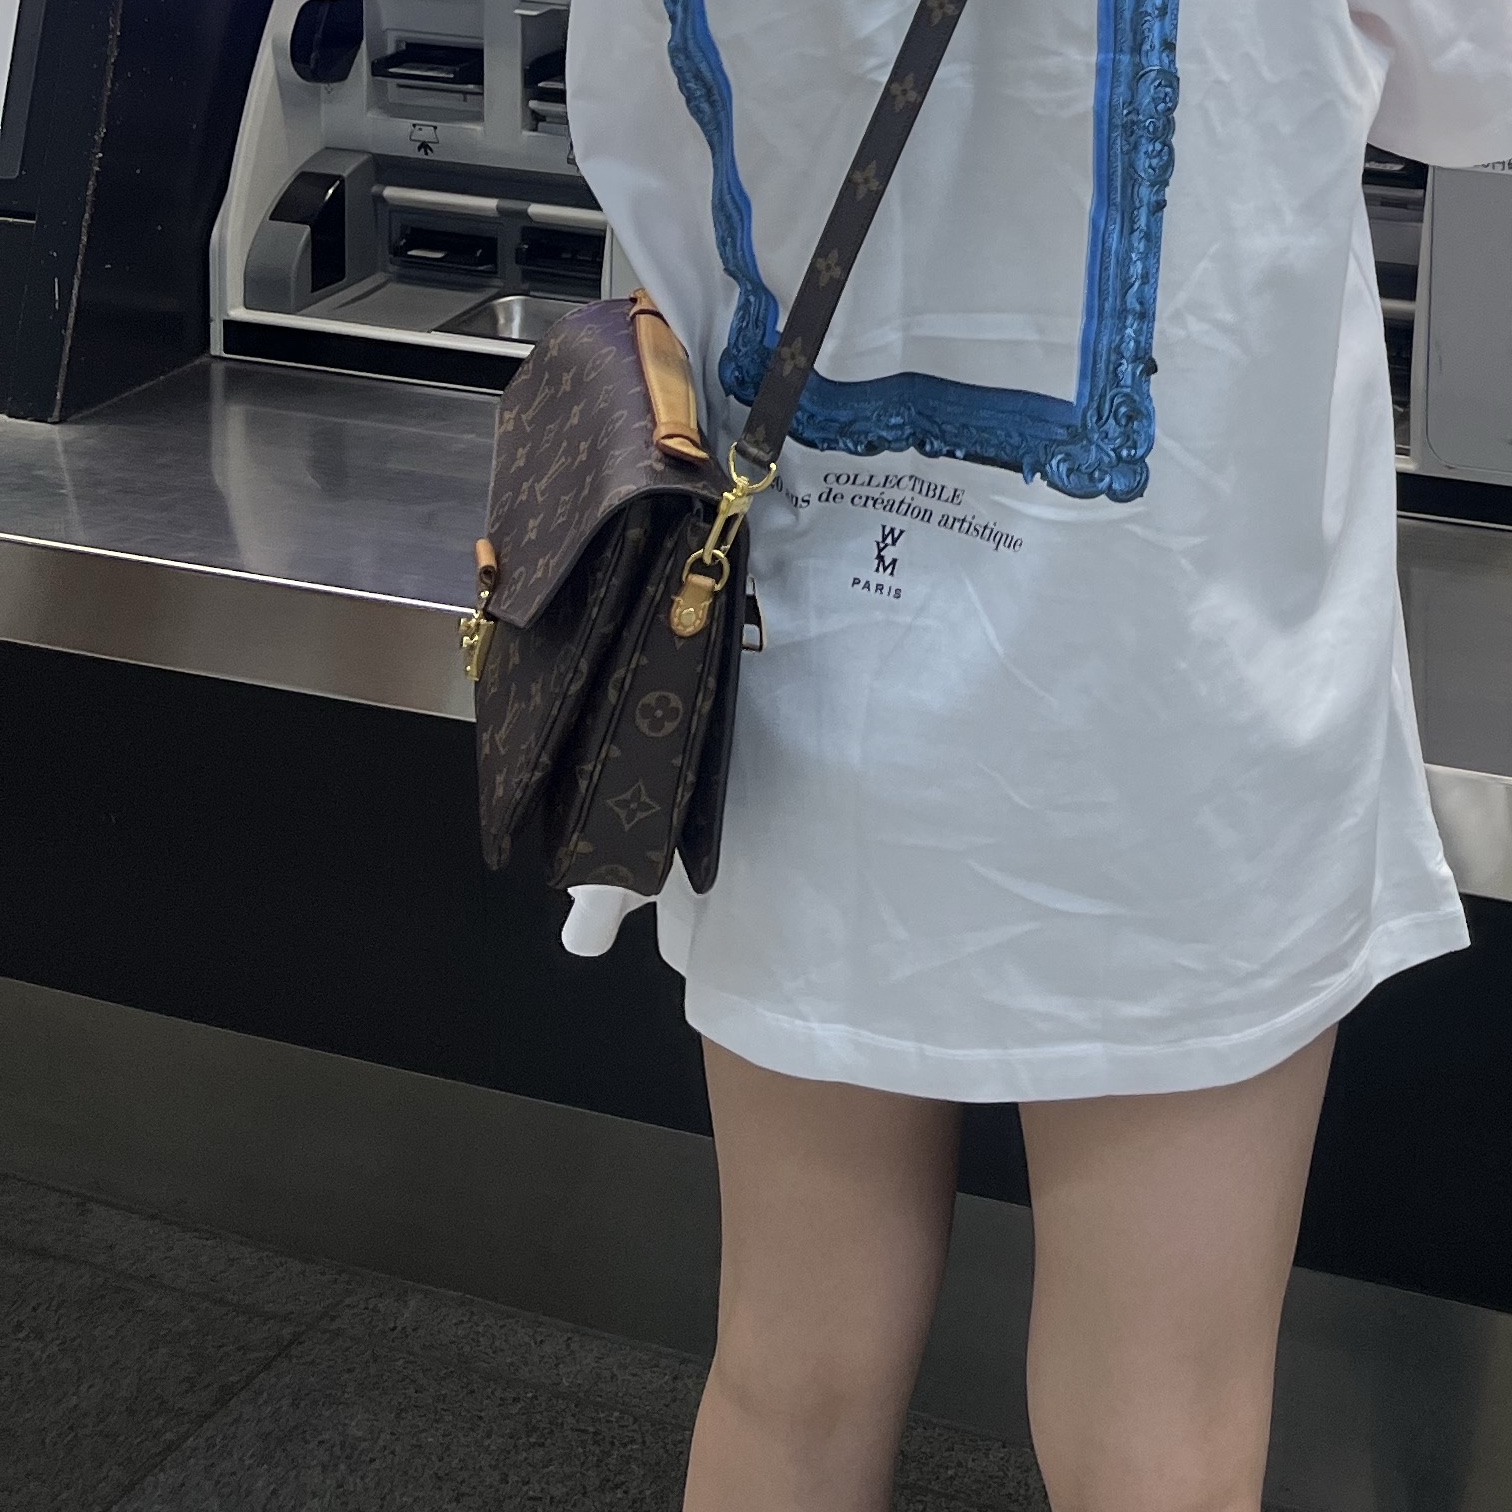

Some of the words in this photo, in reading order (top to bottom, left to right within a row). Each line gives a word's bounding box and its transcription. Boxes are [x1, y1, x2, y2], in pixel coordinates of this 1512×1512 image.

[823, 472, 965, 506] COLLECTIBLE
[818, 487, 844, 504] de
[850, 491, 934, 524] création
[937, 512, 1024, 553] artistique
[851, 577, 902, 599] PARIS
